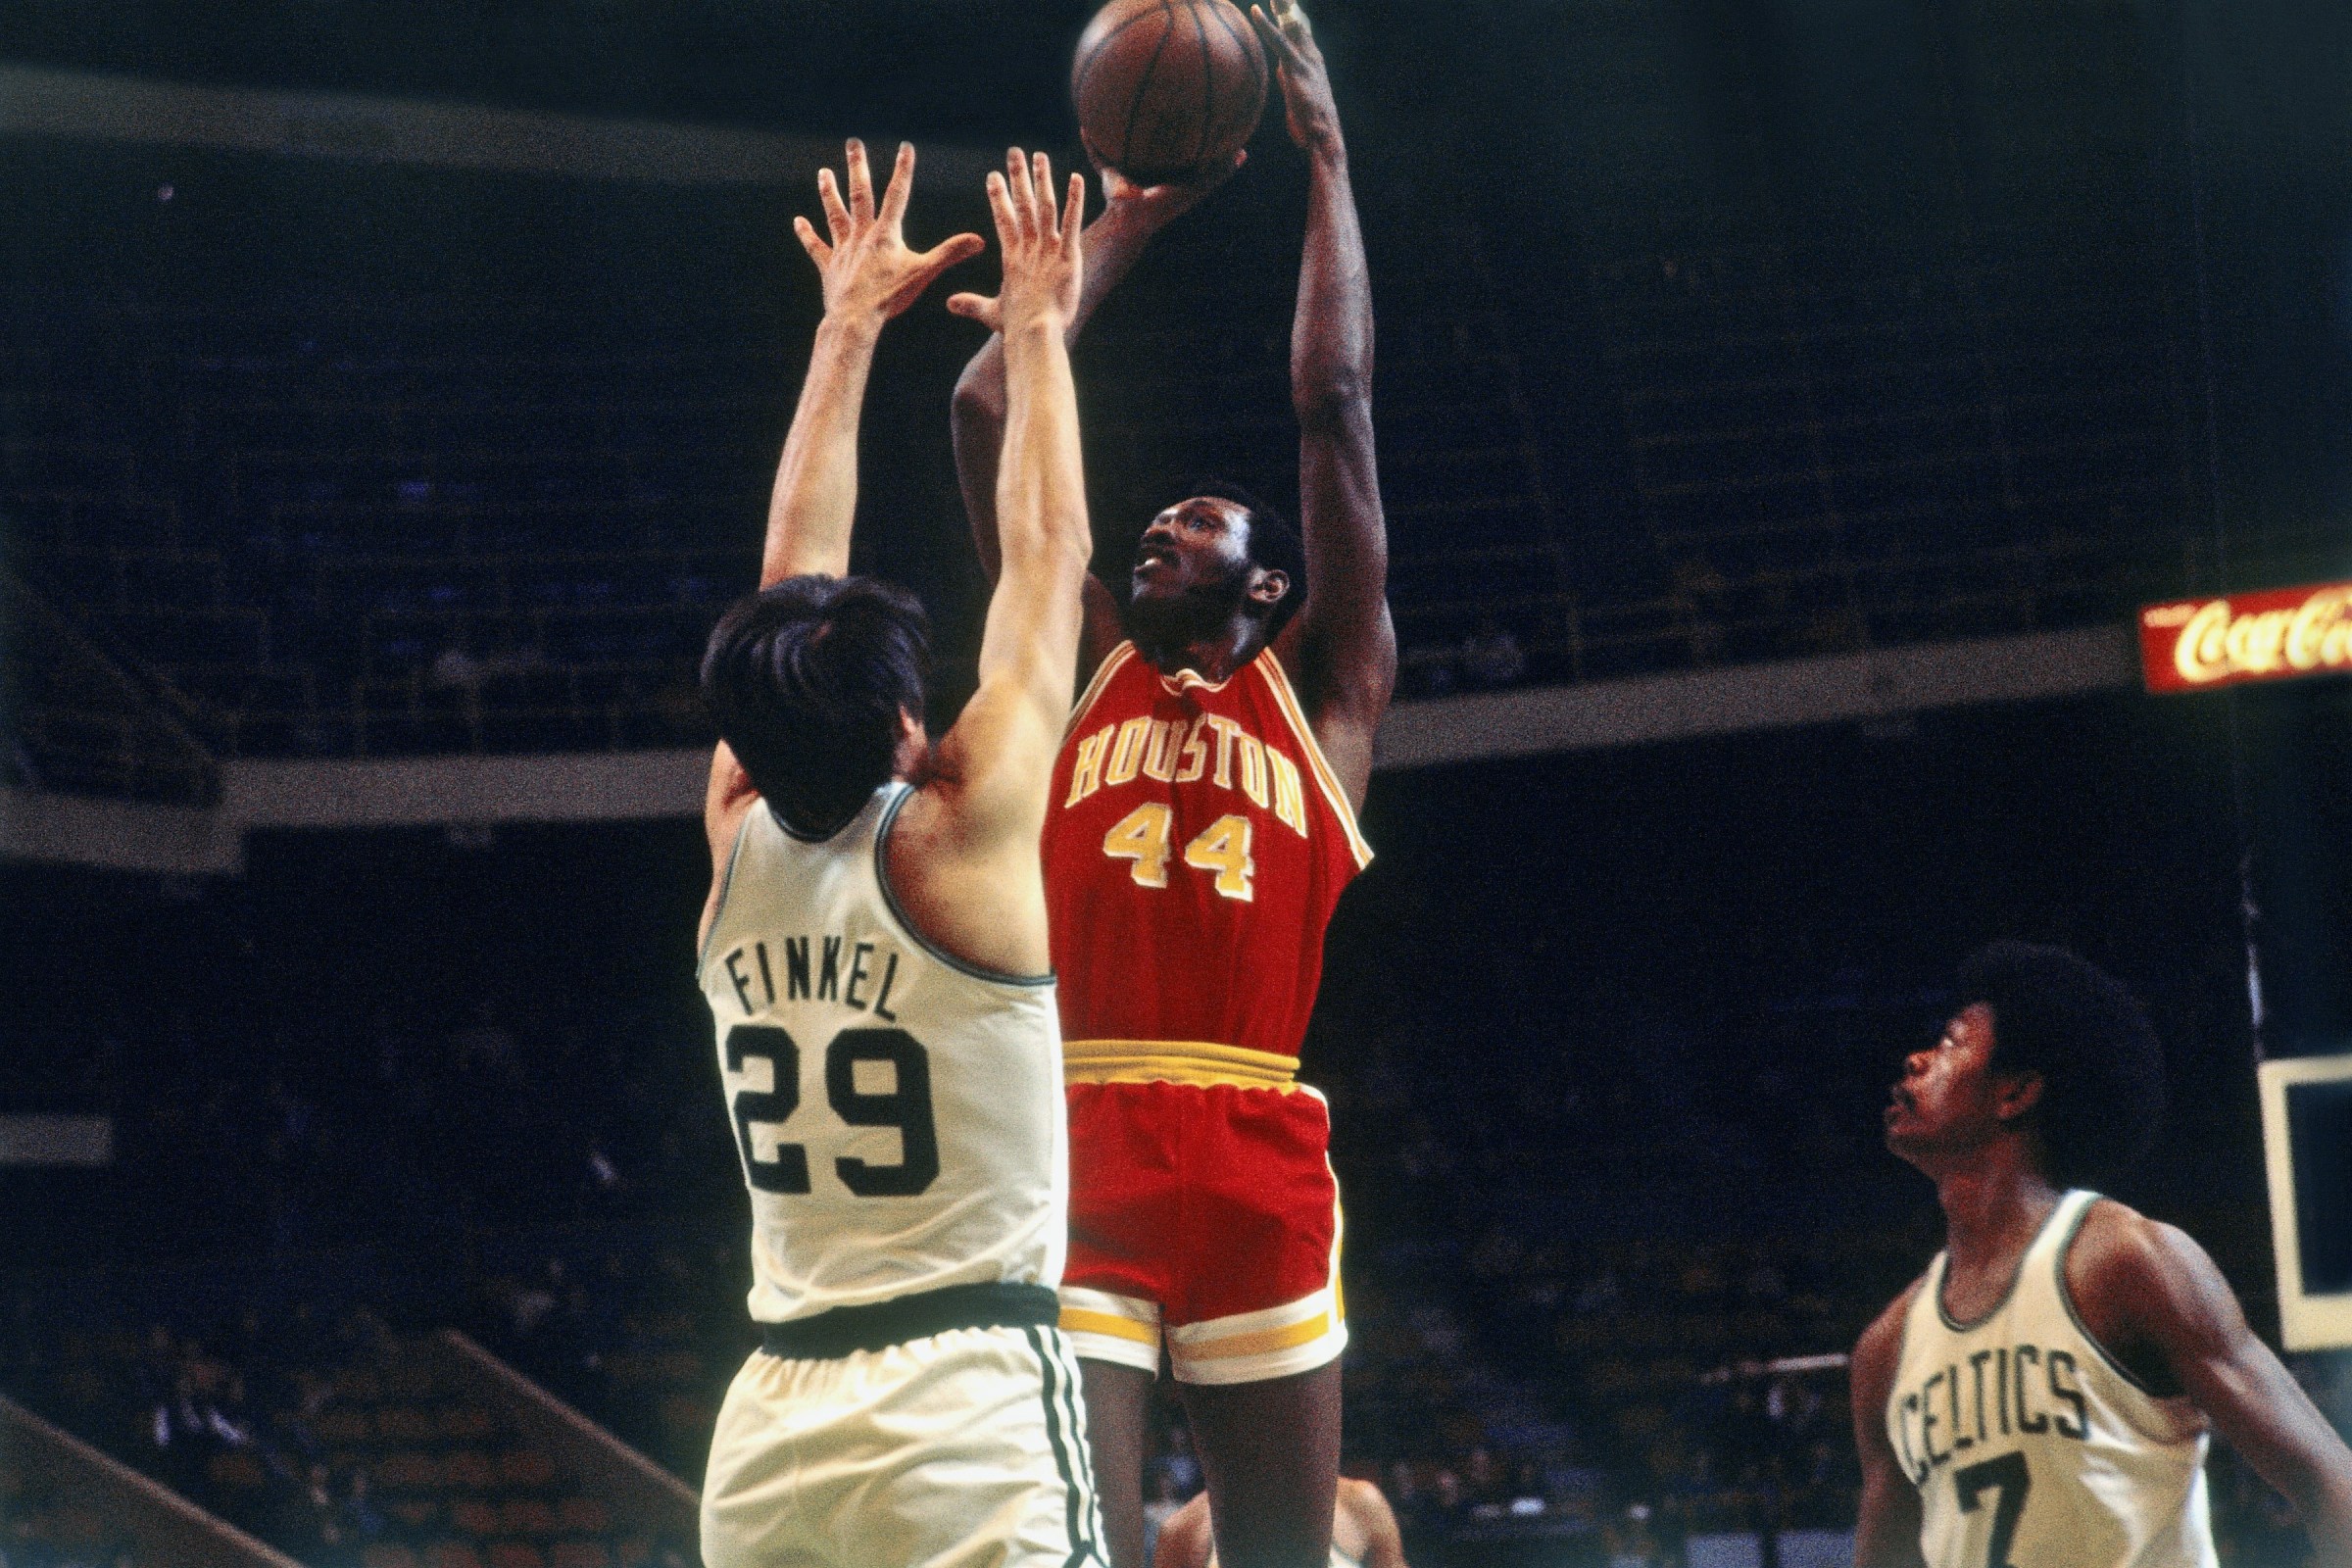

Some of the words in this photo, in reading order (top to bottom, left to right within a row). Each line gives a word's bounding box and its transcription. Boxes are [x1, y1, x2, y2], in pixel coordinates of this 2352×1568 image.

[1064, 712, 1307, 839] HOUSTON
[1102, 802, 1253, 902] 44
[724, 934, 899, 1023] FINKEL
[725, 1024, 941, 1197] 29
[1899, 1344, 2089, 1486] CELTICS
[1953, 1449, 2032, 1568] 7
